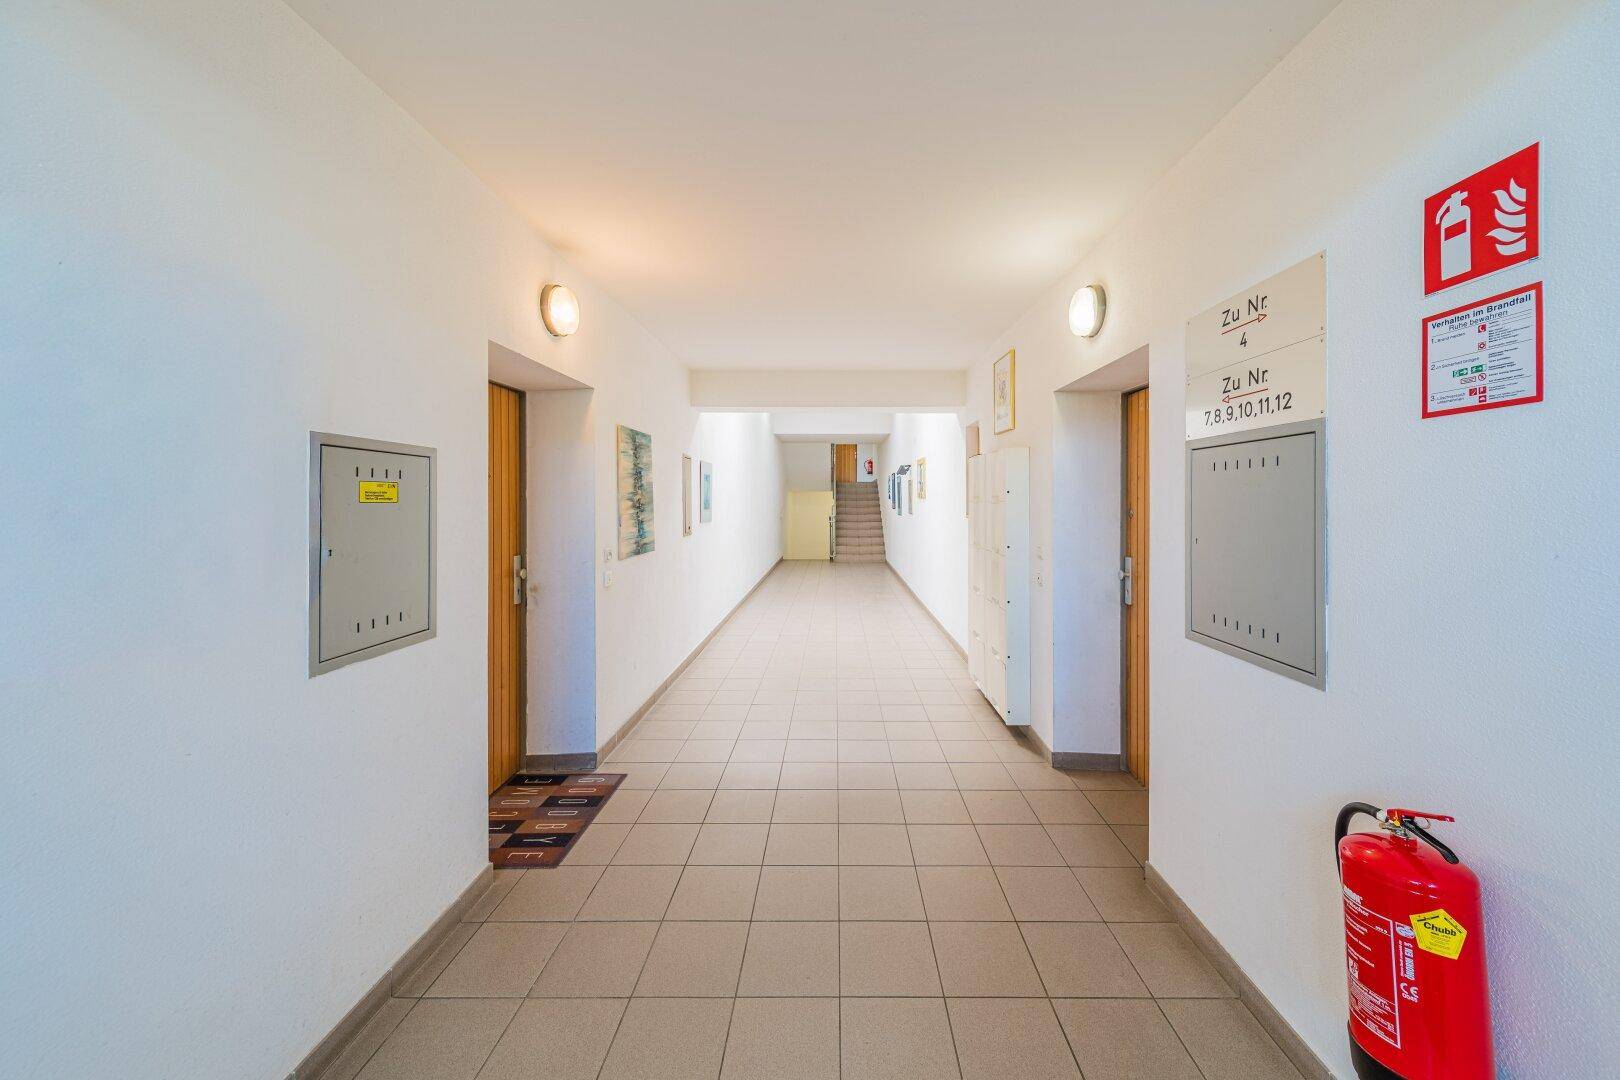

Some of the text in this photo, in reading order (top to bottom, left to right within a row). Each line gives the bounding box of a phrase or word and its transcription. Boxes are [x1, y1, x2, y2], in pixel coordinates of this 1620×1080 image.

[1222, 294, 1268, 328] Zu Nr.
[1431, 312, 1470, 330] Verhalten
[1473, 309, 1484, 317] im
[1487, 294, 1532, 313] Brandfall
[1449, 320, 1468, 331] Ruhe
[1469, 310, 1508, 326] bewahren
[1240, 332, 1247, 348] 4
[1222, 367, 1268, 394] Zu Nr.
[1204, 392, 1292, 426] 7,8,9,10,11,12
[1423, 921, 1457, 937] Chubb
